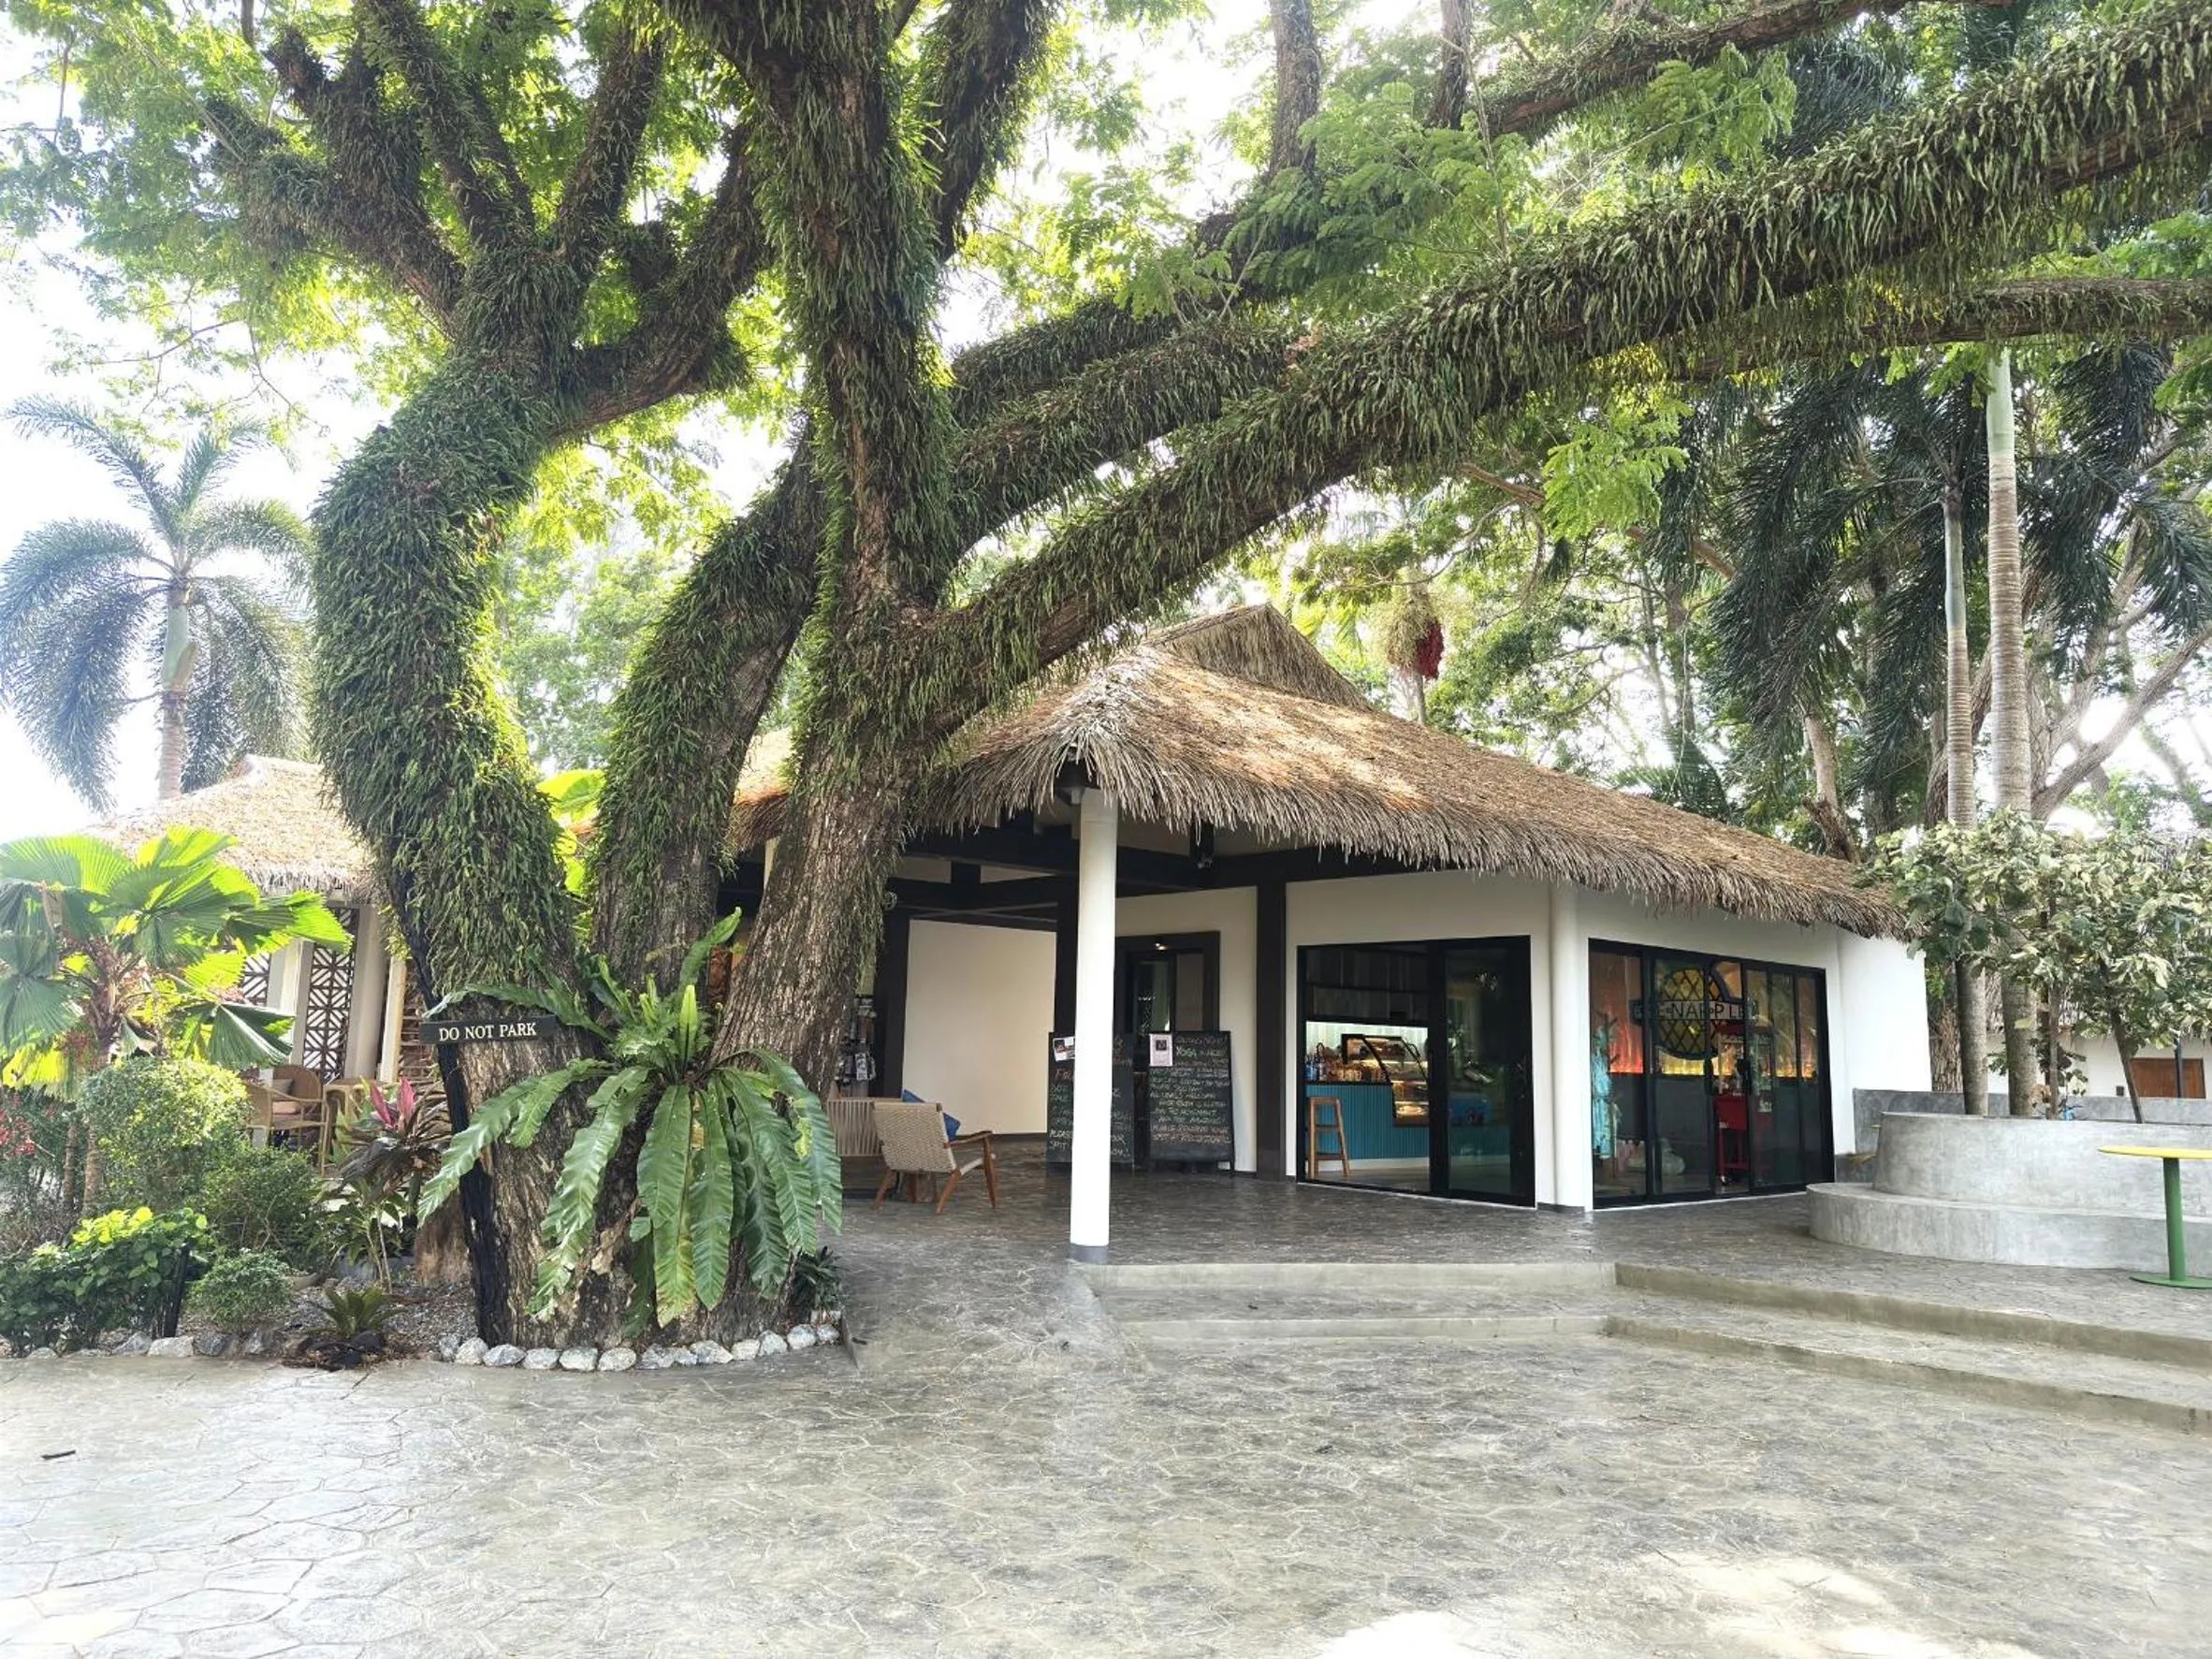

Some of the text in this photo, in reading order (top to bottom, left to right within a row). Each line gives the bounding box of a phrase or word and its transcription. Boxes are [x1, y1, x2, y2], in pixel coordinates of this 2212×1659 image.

[439, 1022, 537, 1041] DO NOT PARK
